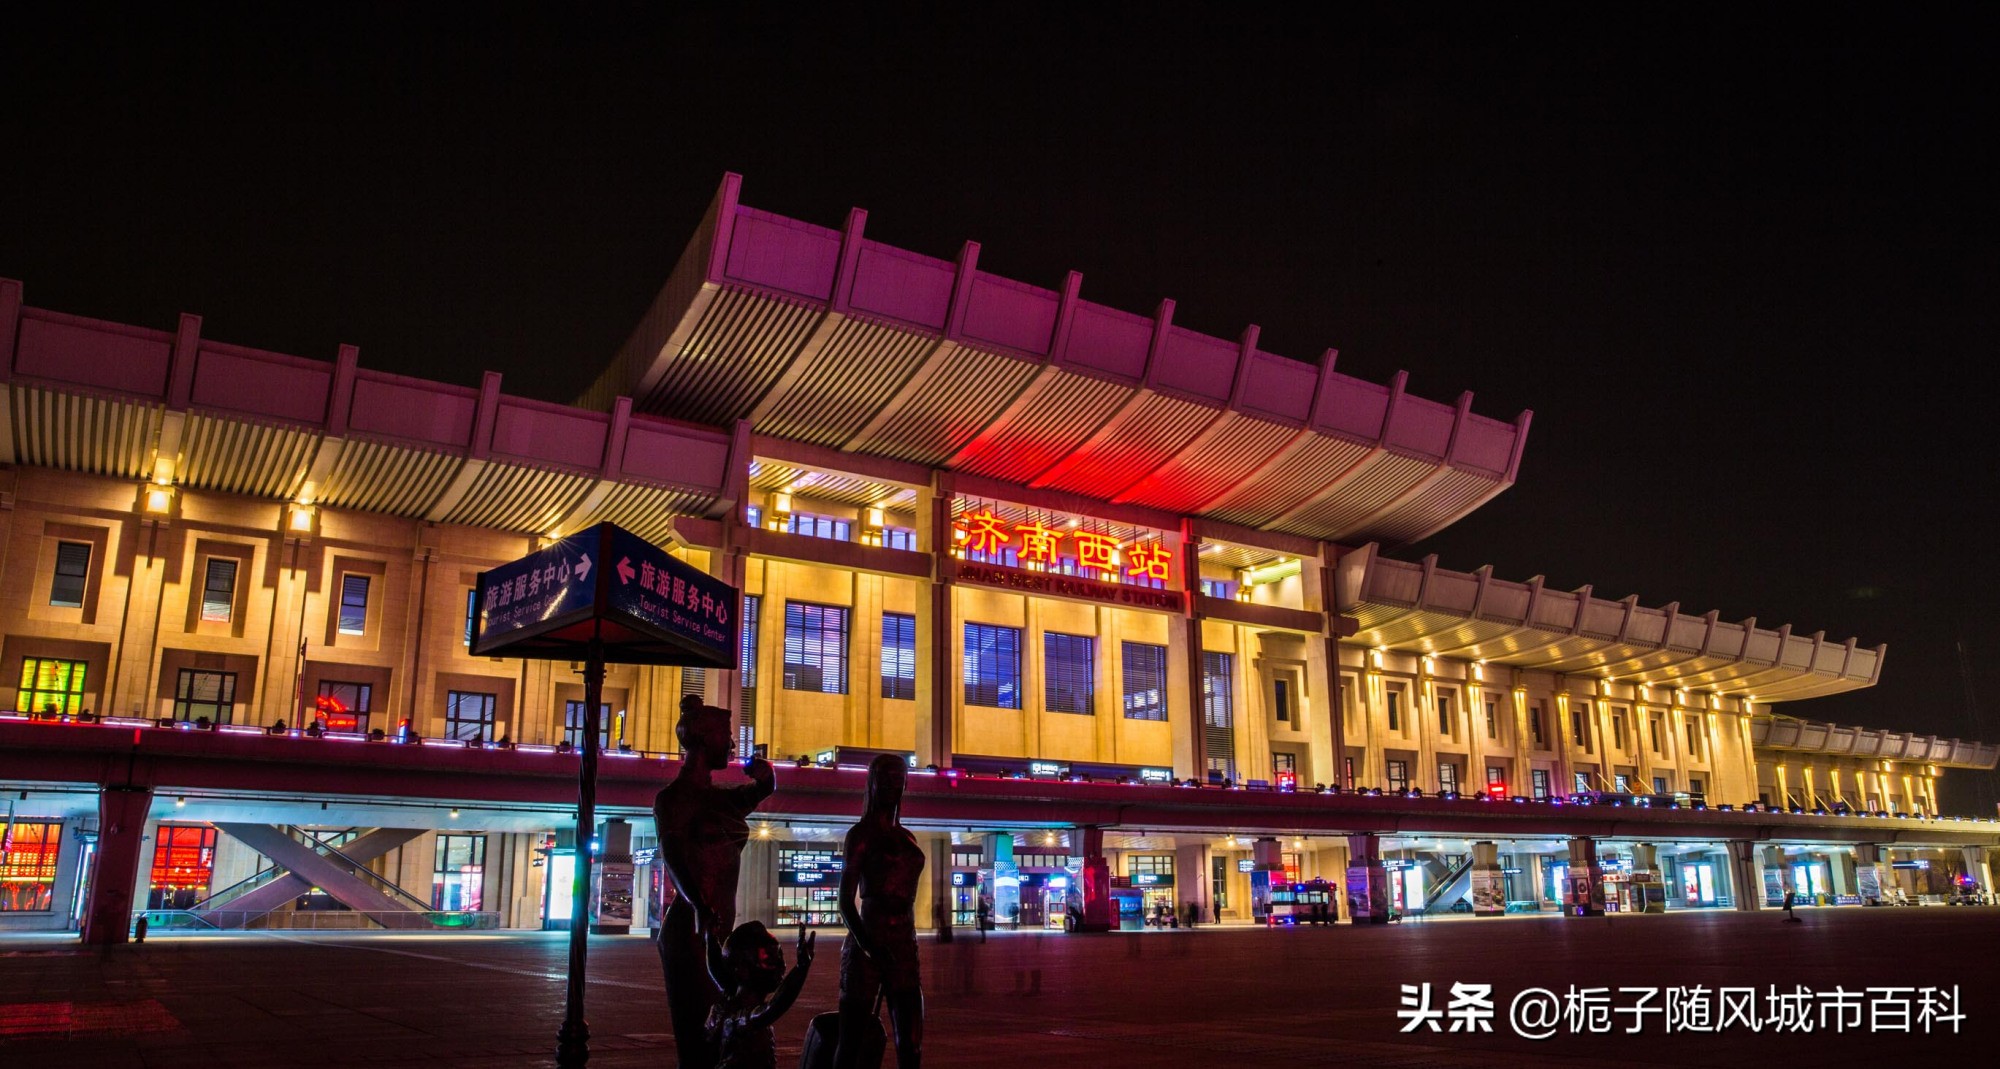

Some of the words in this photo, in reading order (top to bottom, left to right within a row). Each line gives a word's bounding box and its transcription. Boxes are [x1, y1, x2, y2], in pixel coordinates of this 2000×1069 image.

[955, 510, 1173, 580] 济南西站
[486, 557, 571, 611] 旅游服务中心
[640, 560, 728, 625] 旅游服务中心
[958, 565, 1005, 585] JINAN
[1008, 572, 1052, 591] WEST
[1057, 578, 1118, 602] RAILWAY
[1122, 588, 1179, 610] STATION
[486, 609, 511, 627] ourist
[513, 601, 541, 618] Service
[639, 594, 669, 620] Tourist
[672, 609, 701, 633] Service
[703, 623, 726, 642] Center
